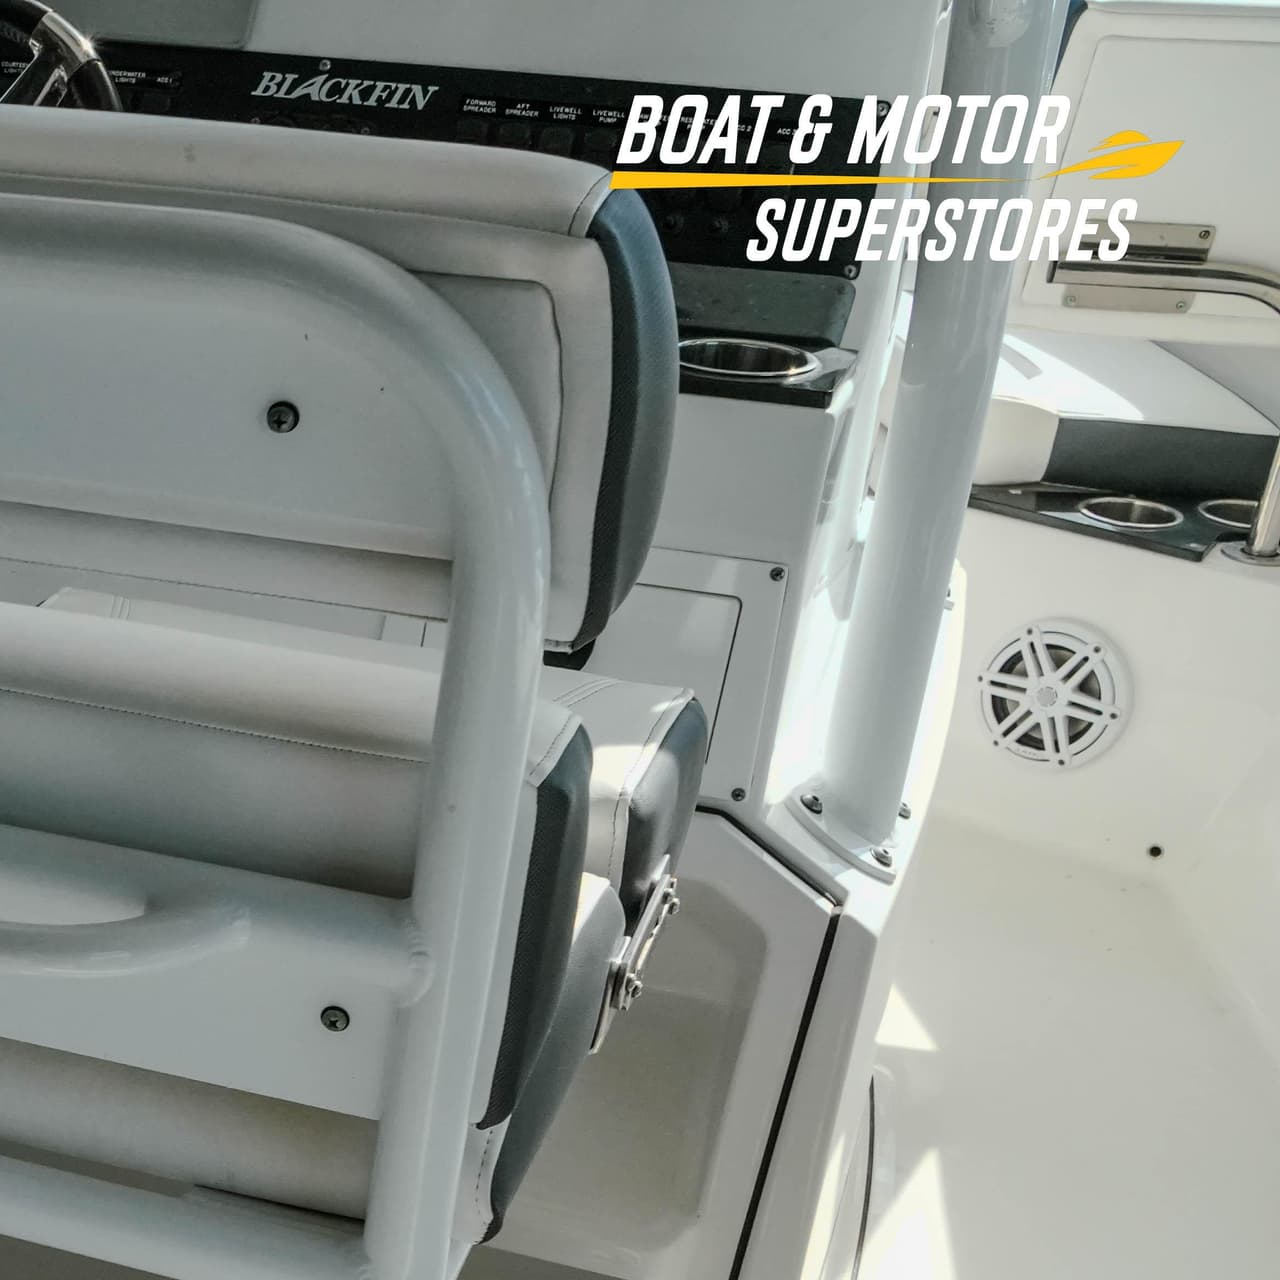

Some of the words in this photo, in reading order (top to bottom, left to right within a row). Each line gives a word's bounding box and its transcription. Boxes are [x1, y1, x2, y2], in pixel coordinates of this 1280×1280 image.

[251, 71, 439, 110] BLACKFIN
[466, 98, 497, 107] FORWARD
[463, 105, 497, 113] SPREADER
[505, 108, 539, 117] SPREADER
[549, 106, 582, 115] LIVEWELL
[592, 109, 625, 118] LIVEWELL
[553, 113, 577, 121] LIGHTS
[598, 116, 618, 124] PUMP
